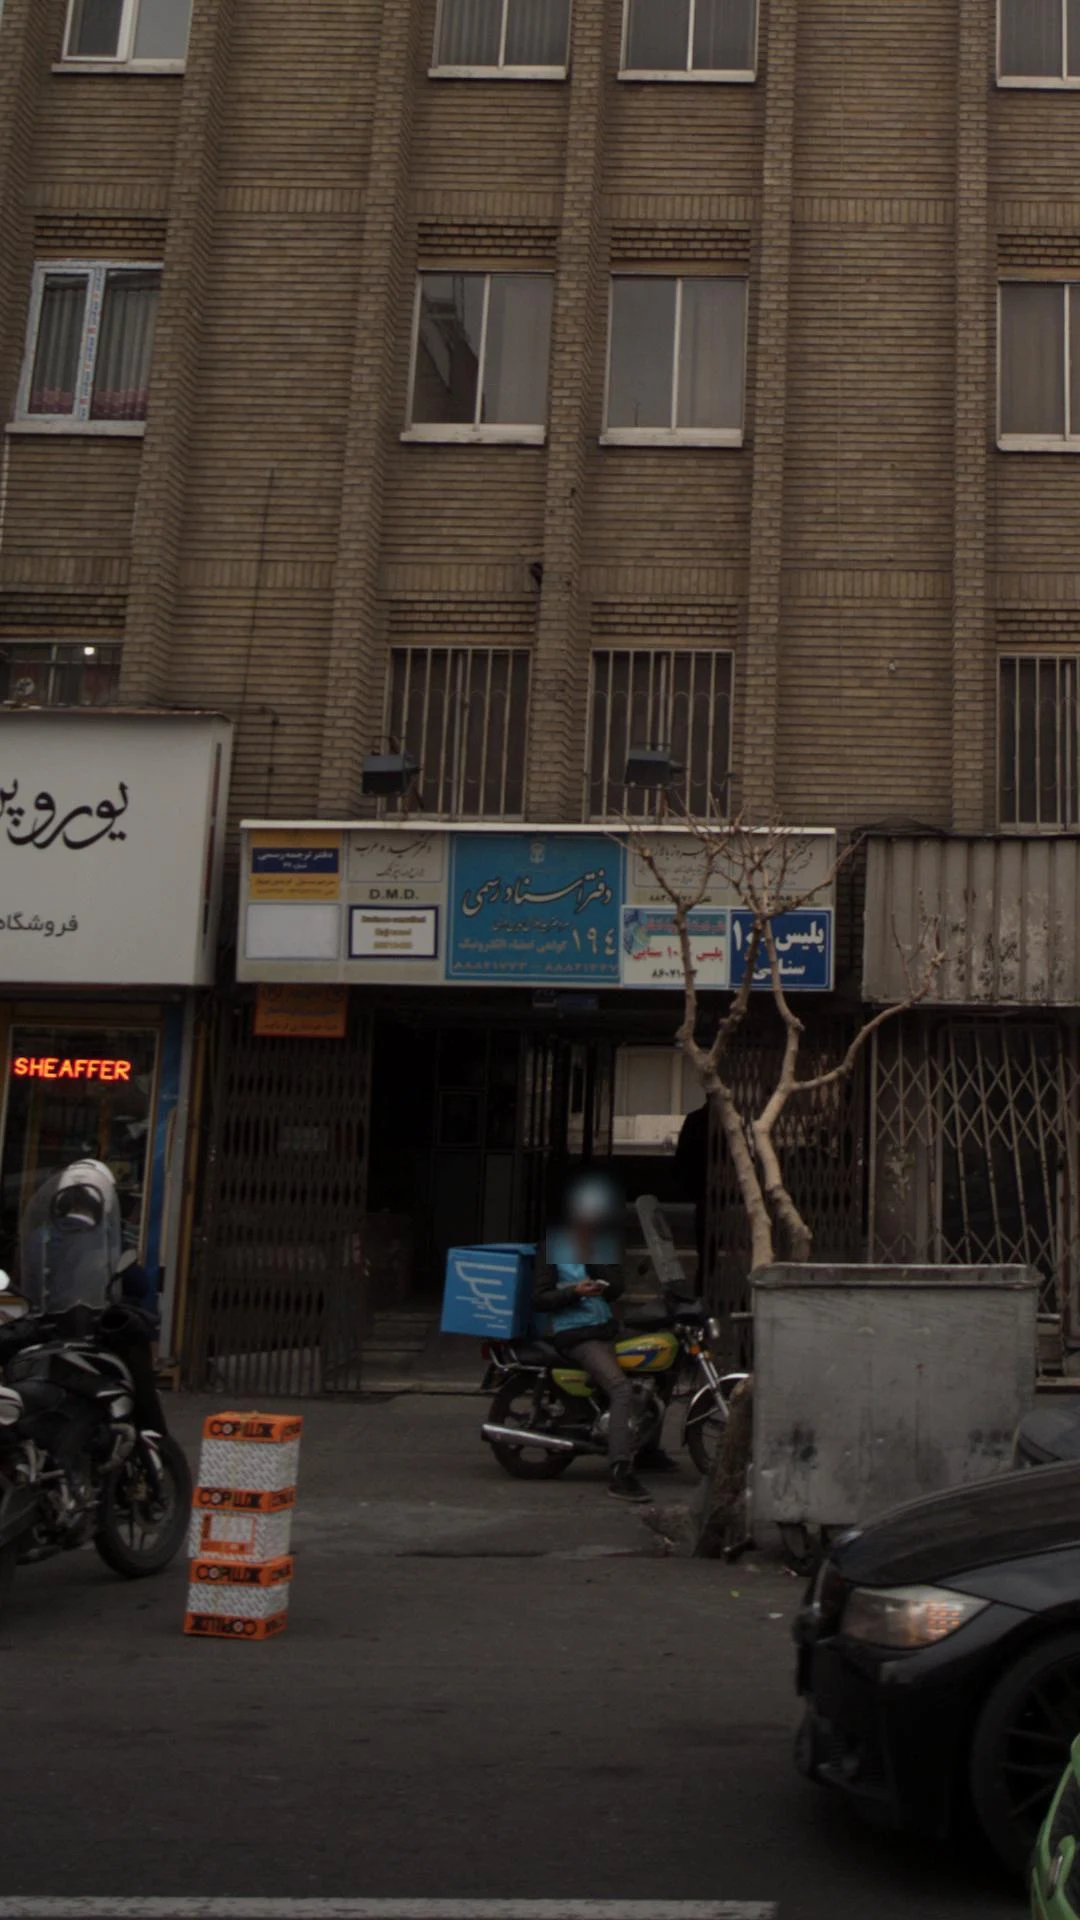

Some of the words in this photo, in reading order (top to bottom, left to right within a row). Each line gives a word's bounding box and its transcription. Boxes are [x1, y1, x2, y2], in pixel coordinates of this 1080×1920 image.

[0, 778, 129, 849] یوروپ
[369, 888, 421, 901] D.M.D.
[462, 876, 501, 917] رسمی
[504, 875, 585, 905] اسناد
[574, 868, 613, 914] دفتر
[774, 920, 825, 953] پلیس
[696, 946, 724, 962] پلیس
[752, 957, 806, 980] سنای
[12, 1056, 132, 1081] SHEAFFER
